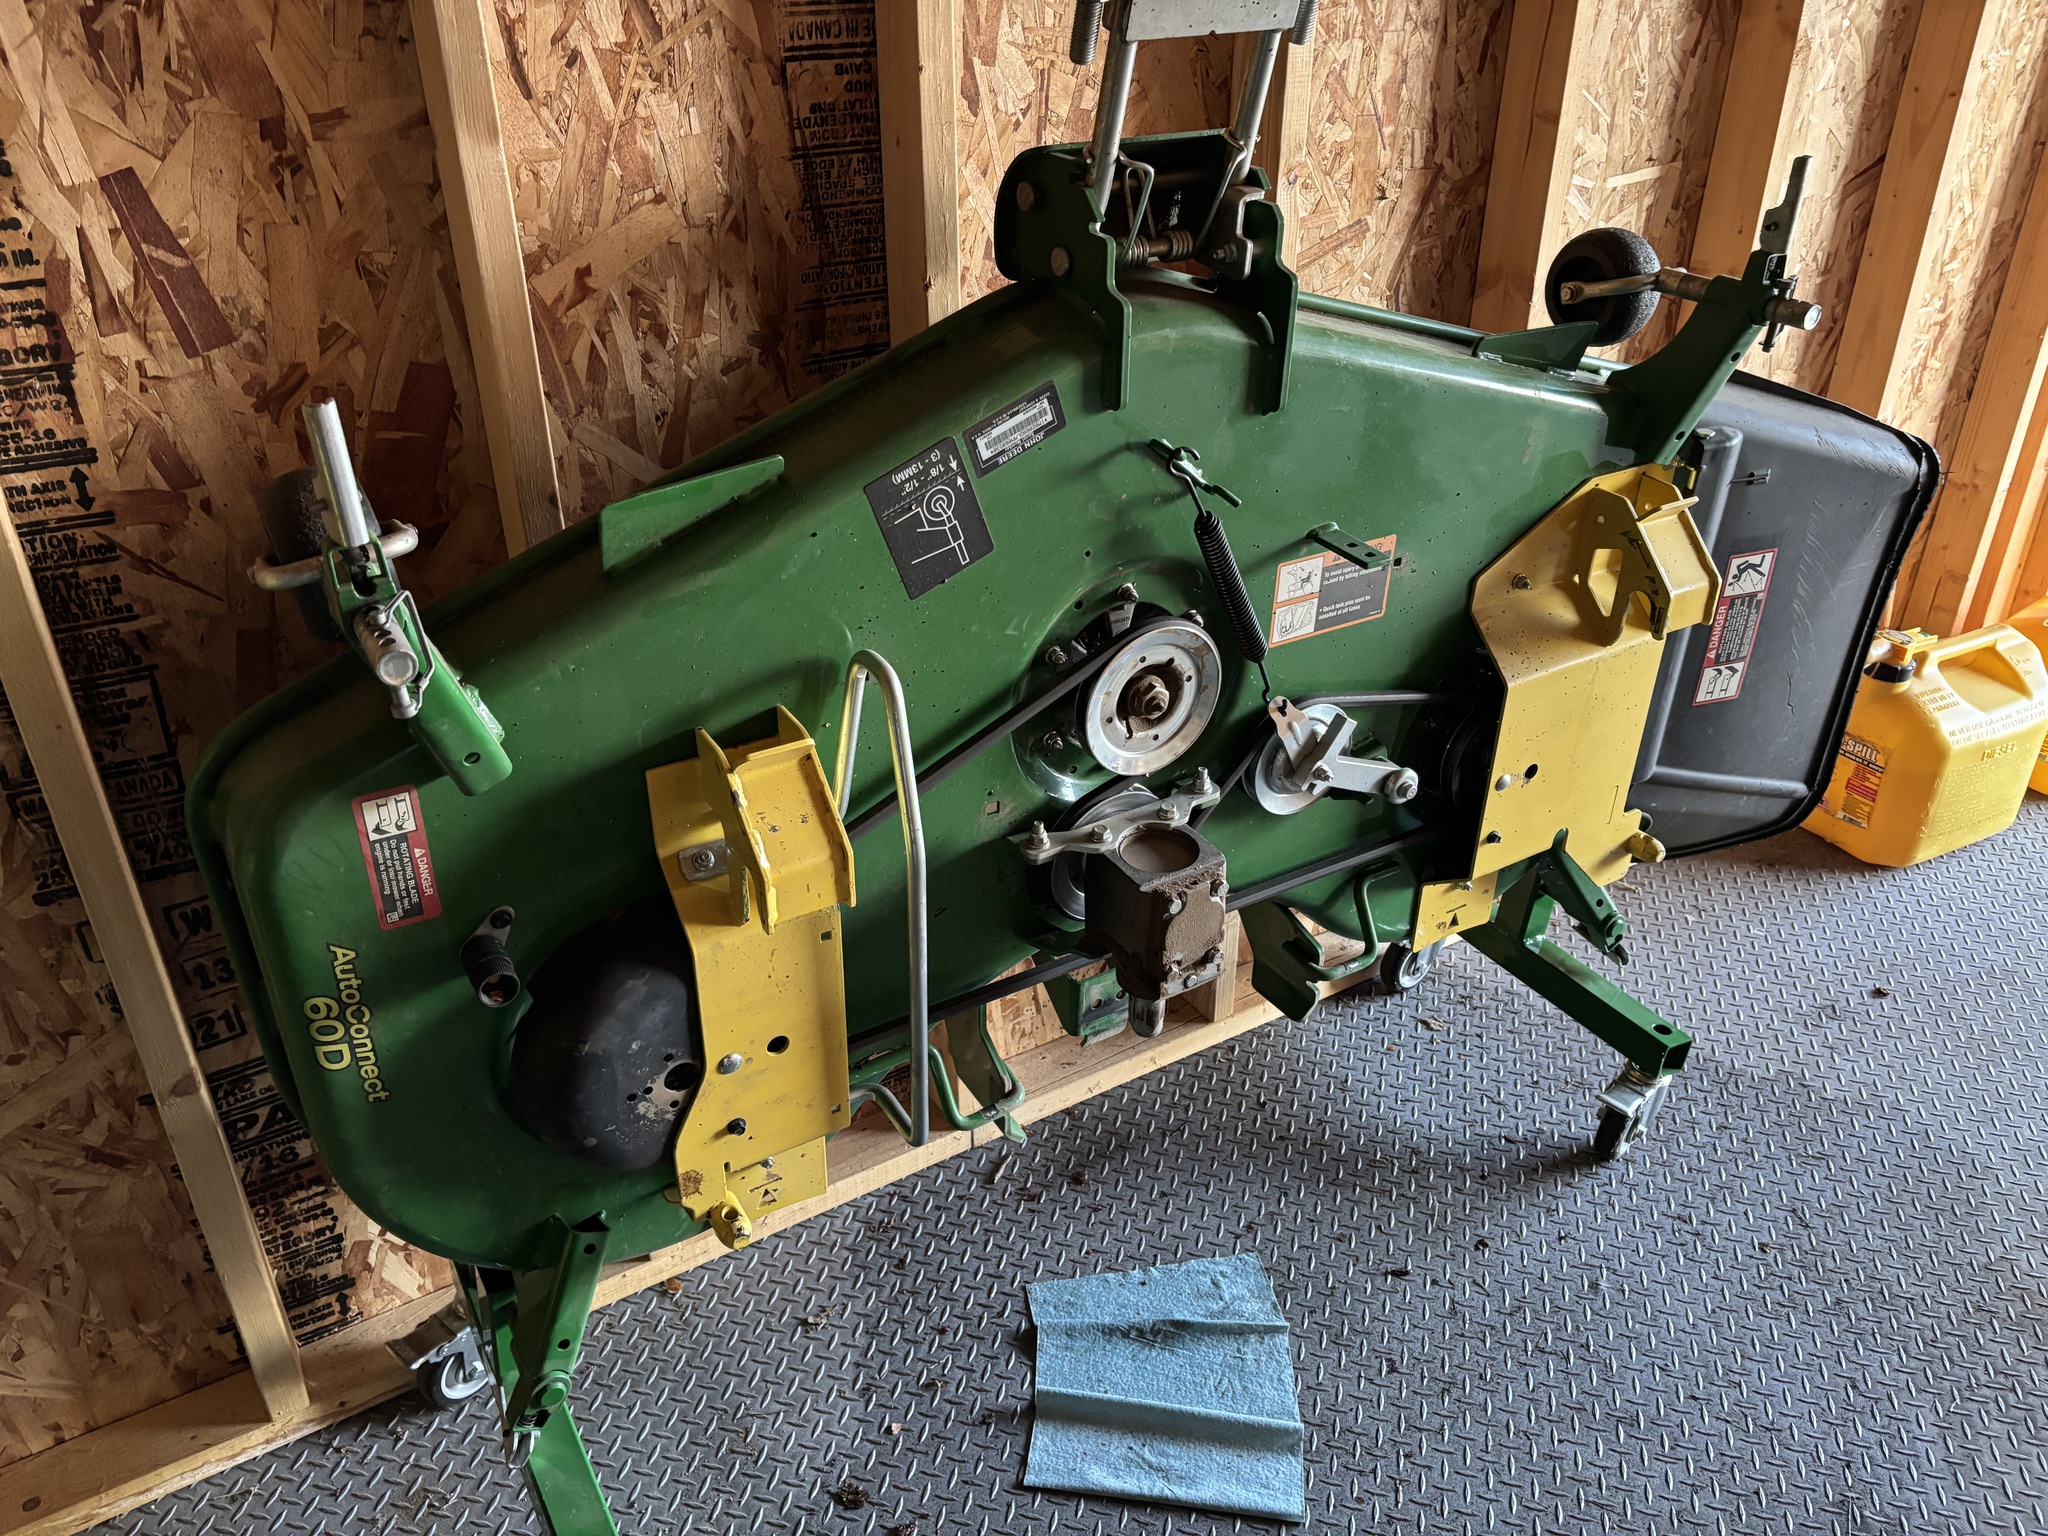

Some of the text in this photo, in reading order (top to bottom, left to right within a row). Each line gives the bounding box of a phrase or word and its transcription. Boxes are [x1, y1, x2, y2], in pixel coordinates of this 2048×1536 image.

[787, 18, 843, 42] CANADA
[1022, 431, 1044, 449] JOHN
[995, 445, 1022, 464] DEERE
[892, 462, 923, 484] 13MM)
[30, 479, 67, 496] AXIS
[1709, 606, 1727, 648] DANGER
[390, 839, 397, 848] Do
[392, 849, 400, 860] not
[374, 843, 384, 863] engine
[381, 871, 391, 895] running
[382, 841, 391, 859] under
[391, 880, 400, 900] mower
[393, 860, 402, 871] put
[400, 842, 419, 904] ROTATING BLADE
[417, 857, 433, 895] DANGER
[397, 871, 406, 890] hands
[192, 956, 235, 991] 13
[303, 996, 352, 1071] 60D
[328, 944, 390, 1103] AutoConnect
